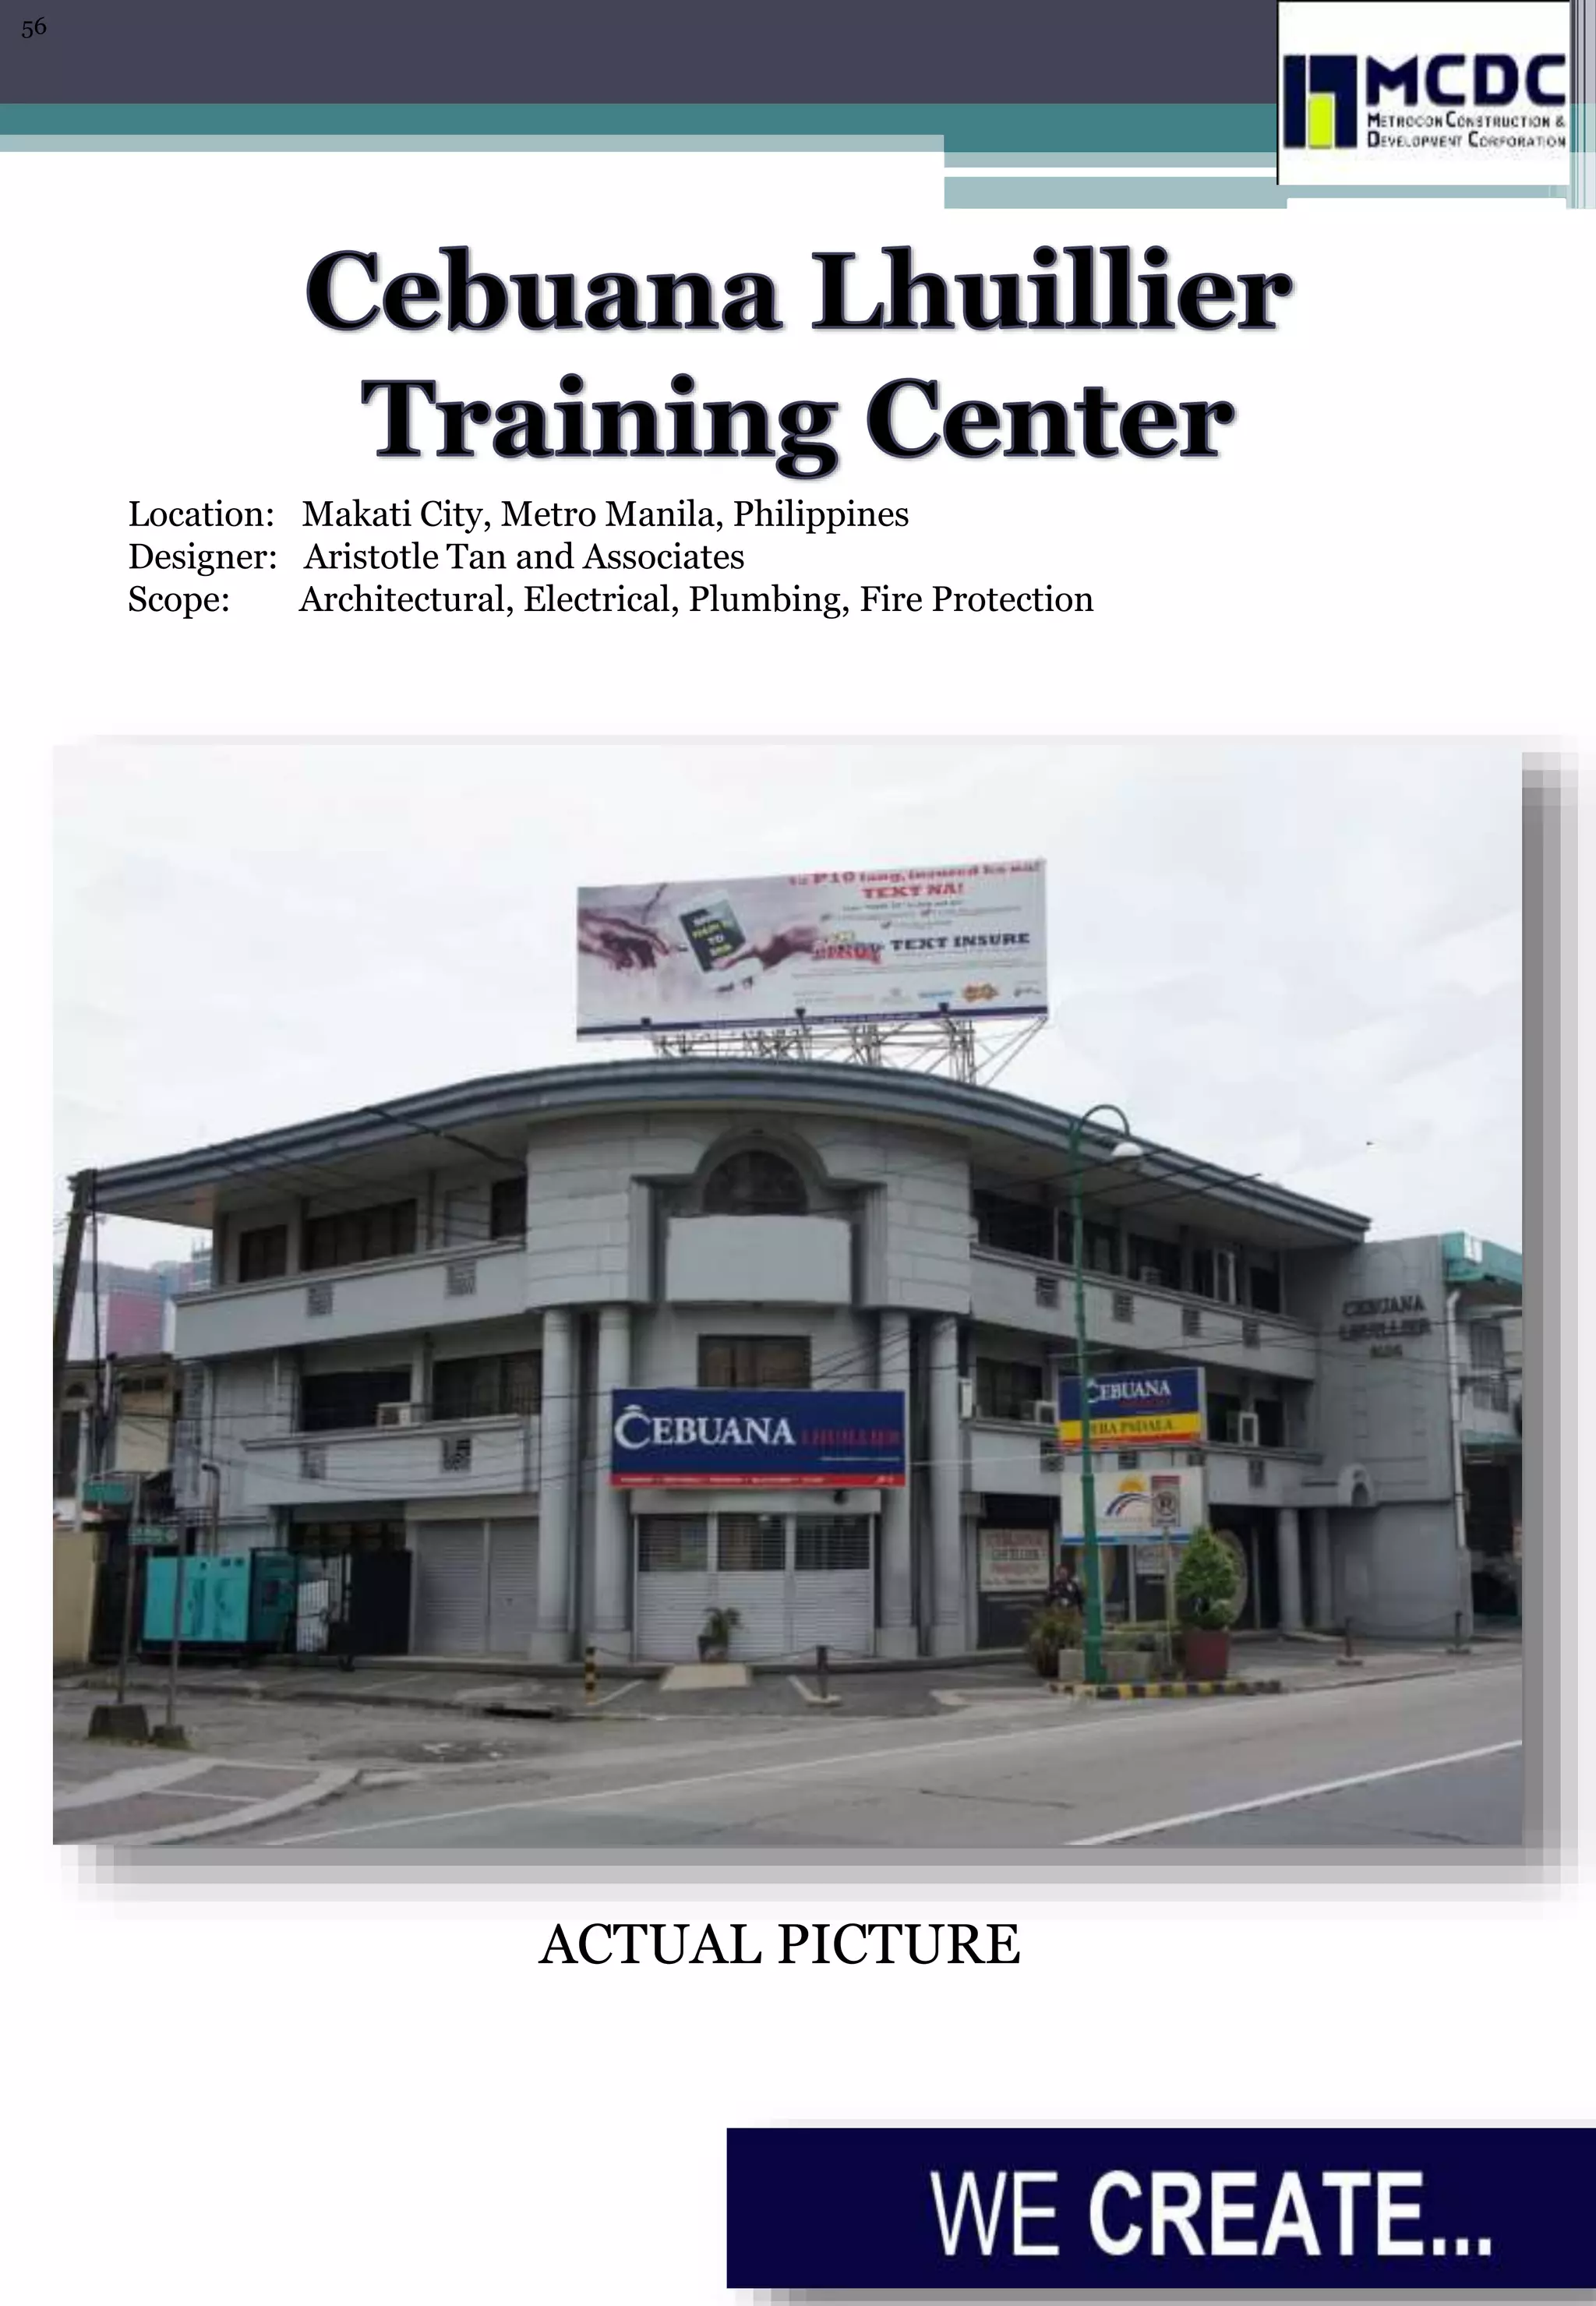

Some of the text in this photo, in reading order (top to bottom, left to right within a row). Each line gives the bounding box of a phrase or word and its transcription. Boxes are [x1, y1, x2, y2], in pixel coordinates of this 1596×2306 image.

[861, 882, 964, 899] TEXT NA!
[890, 936, 949, 952] TEXT
[953, 933, 1030, 948] INSURE
[1087, 1379, 1172, 1403] CEBUANA
[614, 1404, 796, 1450] CEBUANA
